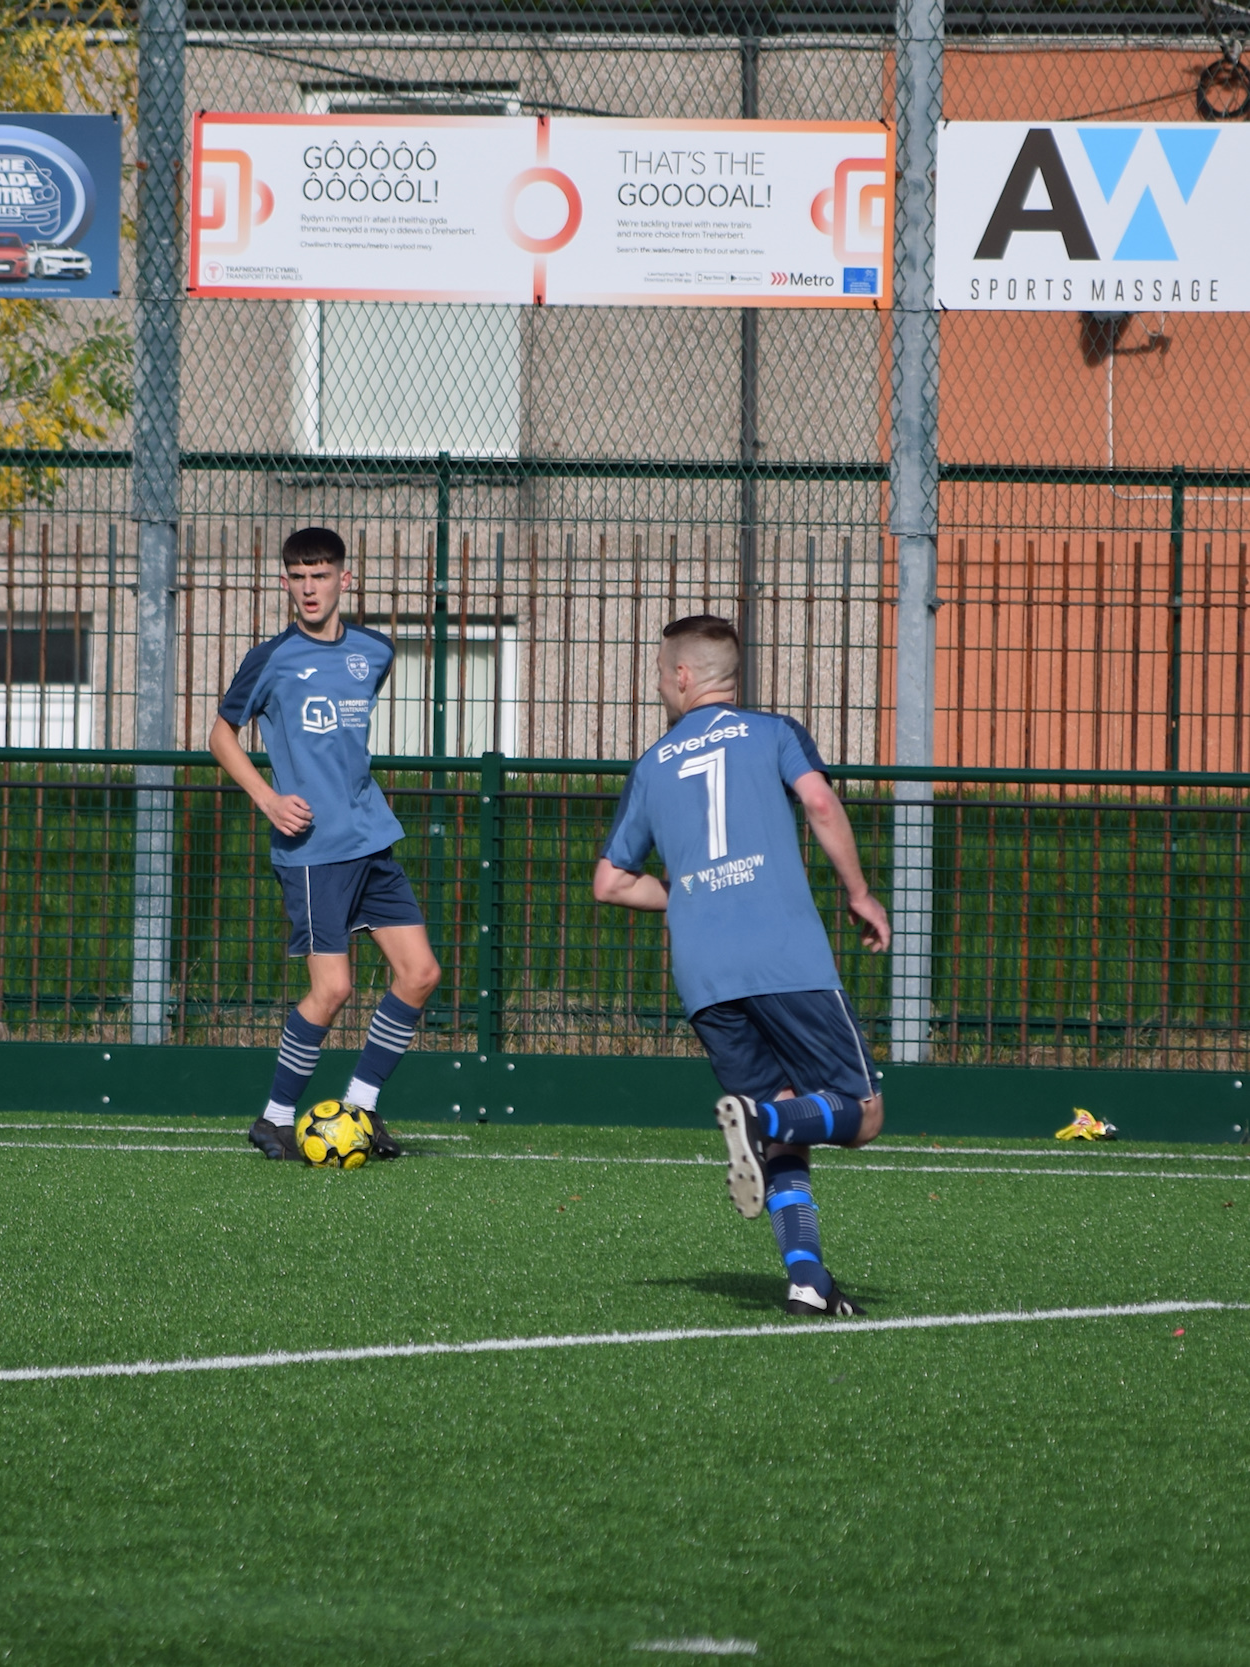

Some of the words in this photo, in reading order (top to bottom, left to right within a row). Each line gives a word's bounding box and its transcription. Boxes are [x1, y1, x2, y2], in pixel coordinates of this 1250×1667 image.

[303, 140, 437, 171] GÔÔÔÔÔ
[618, 150, 706, 175] THAT'S
[714, 152, 765, 176] THE
[303, 171, 438, 204] ÔÔÔÔÔL!
[618, 183, 771, 208] GOOOOAL!
[973, 128, 1221, 261] AW
[301, 214, 324, 224] Rydyn
[341, 216, 362, 224] mynd
[429, 218, 447, 226] gyda
[332, 226, 362, 235] newydd
[371, 228, 388, 236] mwy
[618, 220, 639, 228] We're
[641, 220, 669, 229] tackling
[671, 221, 693, 229] travel
[695, 221, 711, 229] with
[703, 231, 744, 239] Treherbert.
[790, 273, 834, 286] Metro
[971, 279, 1072, 300] SPORTS
[1092, 280, 1218, 301] MASSAGE
[658, 723, 749, 763] Everest
[678, 747, 728, 861] 7
[697, 868, 716, 884] W2
[716, 854, 765, 877] WINDOW
[710, 869, 755, 892] SYSTEMS
